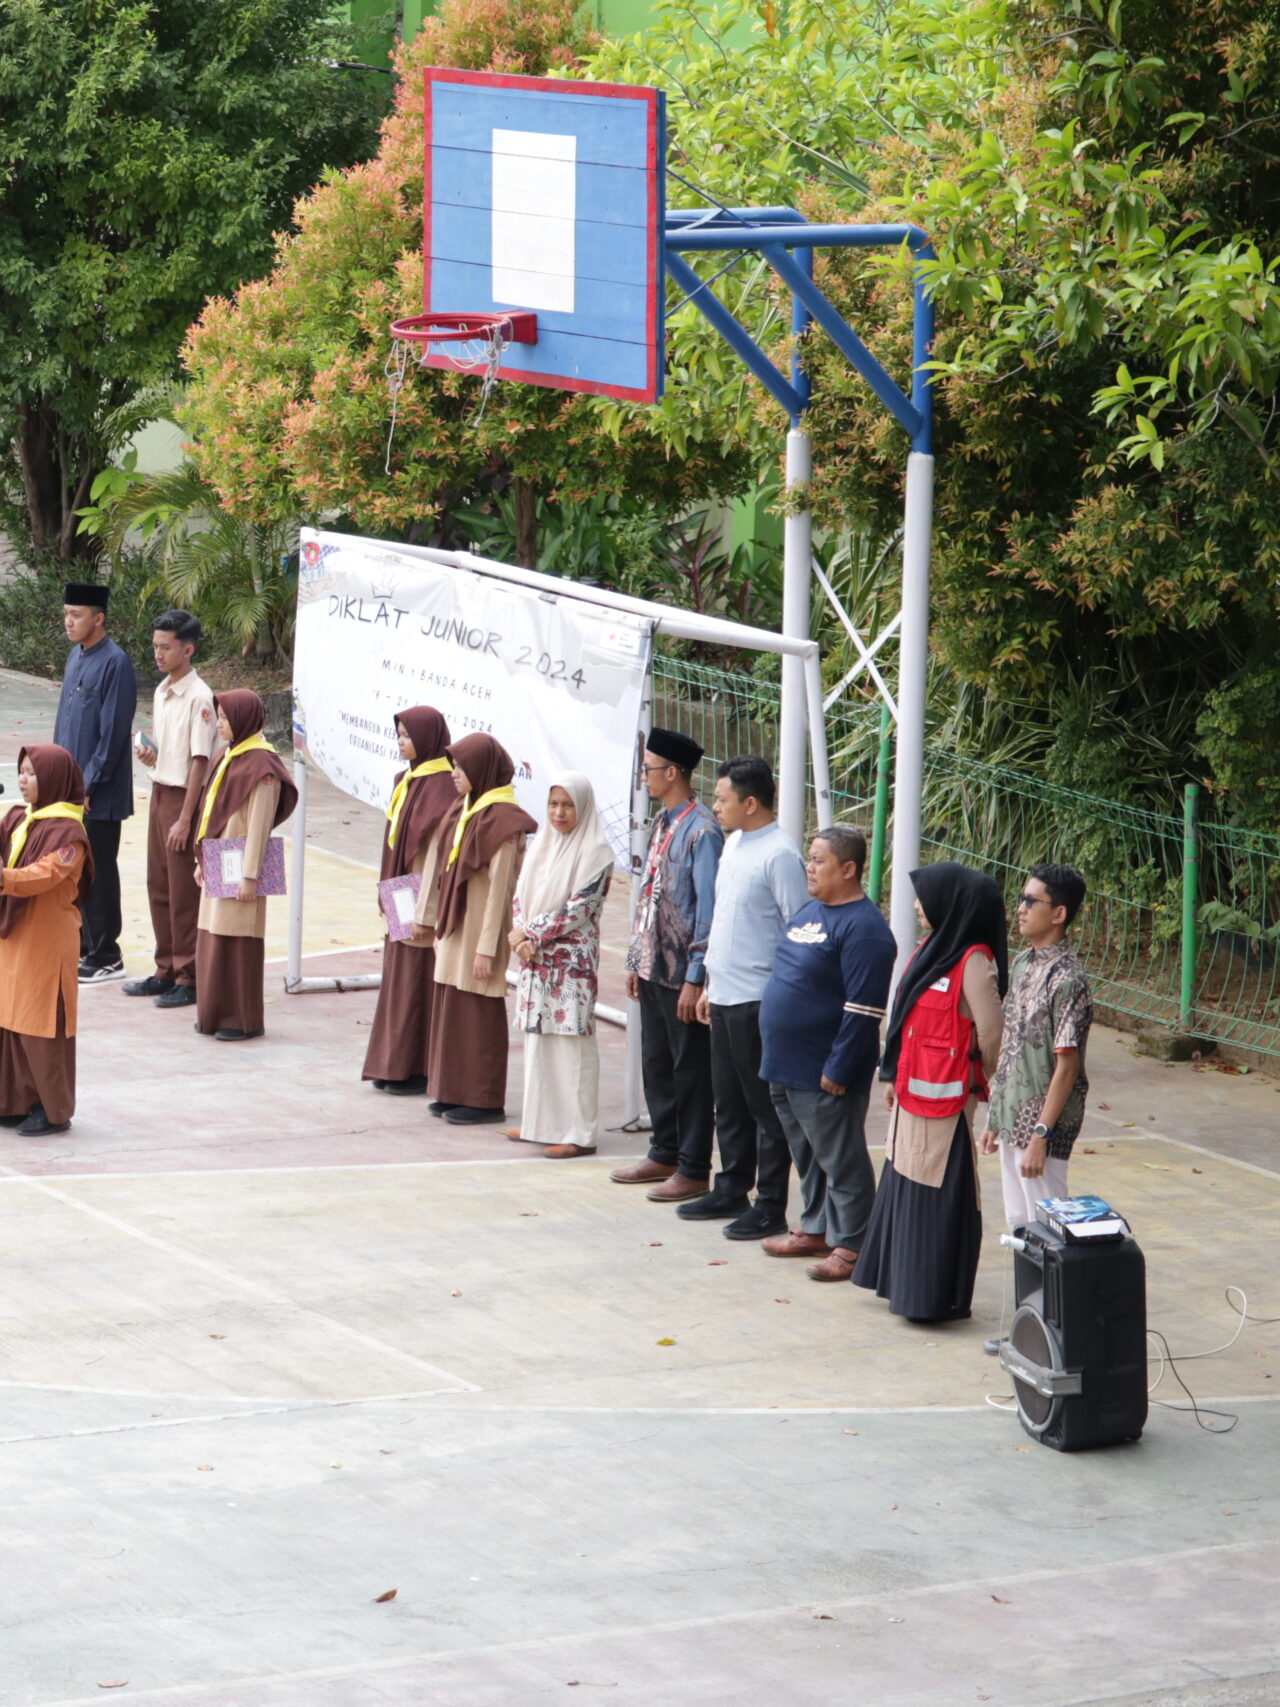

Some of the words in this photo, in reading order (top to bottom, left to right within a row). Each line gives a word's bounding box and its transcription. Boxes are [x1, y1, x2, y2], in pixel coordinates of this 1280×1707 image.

[328, 594, 410, 629] DIKLAT
[420, 615, 503, 659] JUNIOR
[514, 645, 587, 689] 2024
[381, 659, 406, 675] MN
[420, 669, 456, 689] BANDA
[462, 682, 492, 701] ACEH
[463, 716, 492, 733] 2024
[389, 748, 408, 765] YA
